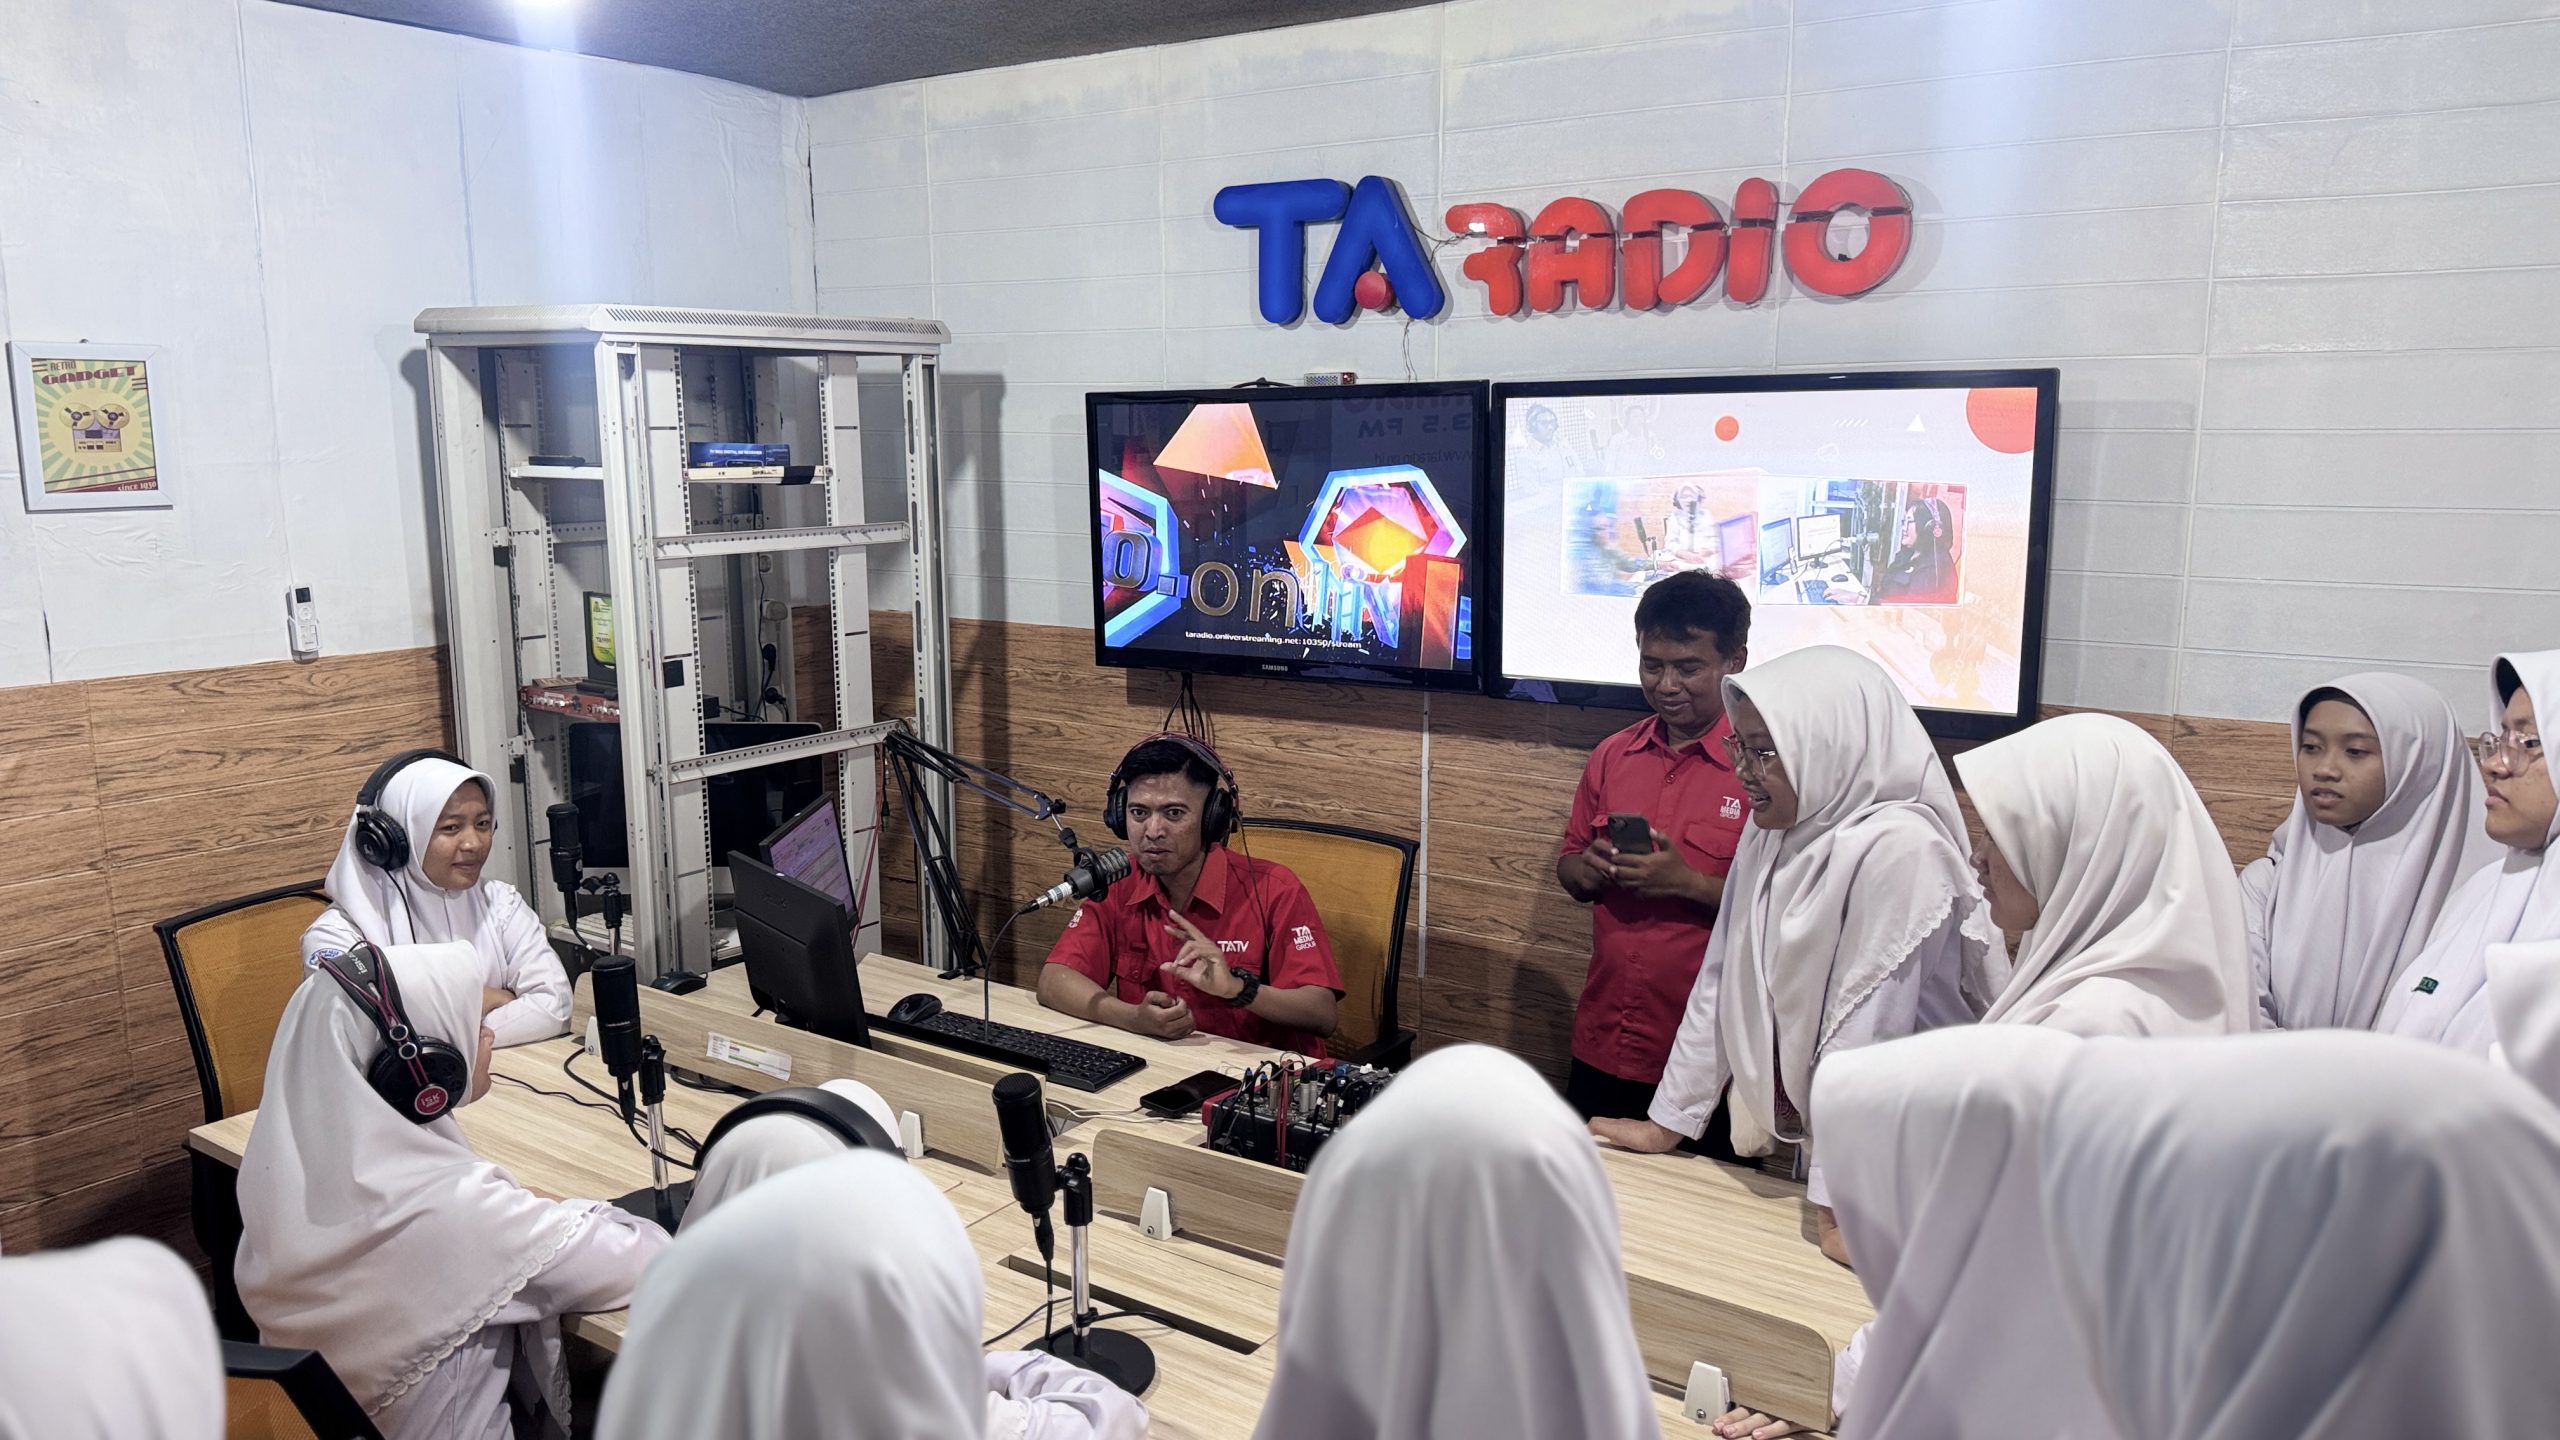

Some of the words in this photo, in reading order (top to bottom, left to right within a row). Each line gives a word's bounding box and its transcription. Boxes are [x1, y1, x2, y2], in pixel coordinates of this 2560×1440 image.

[1213, 175, 1445, 325] TA
[50, 361, 77, 371] RETRO
[41, 366, 137, 384] GADGET
[1722, 795, 1741, 809] TA
[1290, 925, 1311, 937] TA
[1217, 940, 1249, 953] TATV
[1293, 935, 1314, 945] MEDIA
